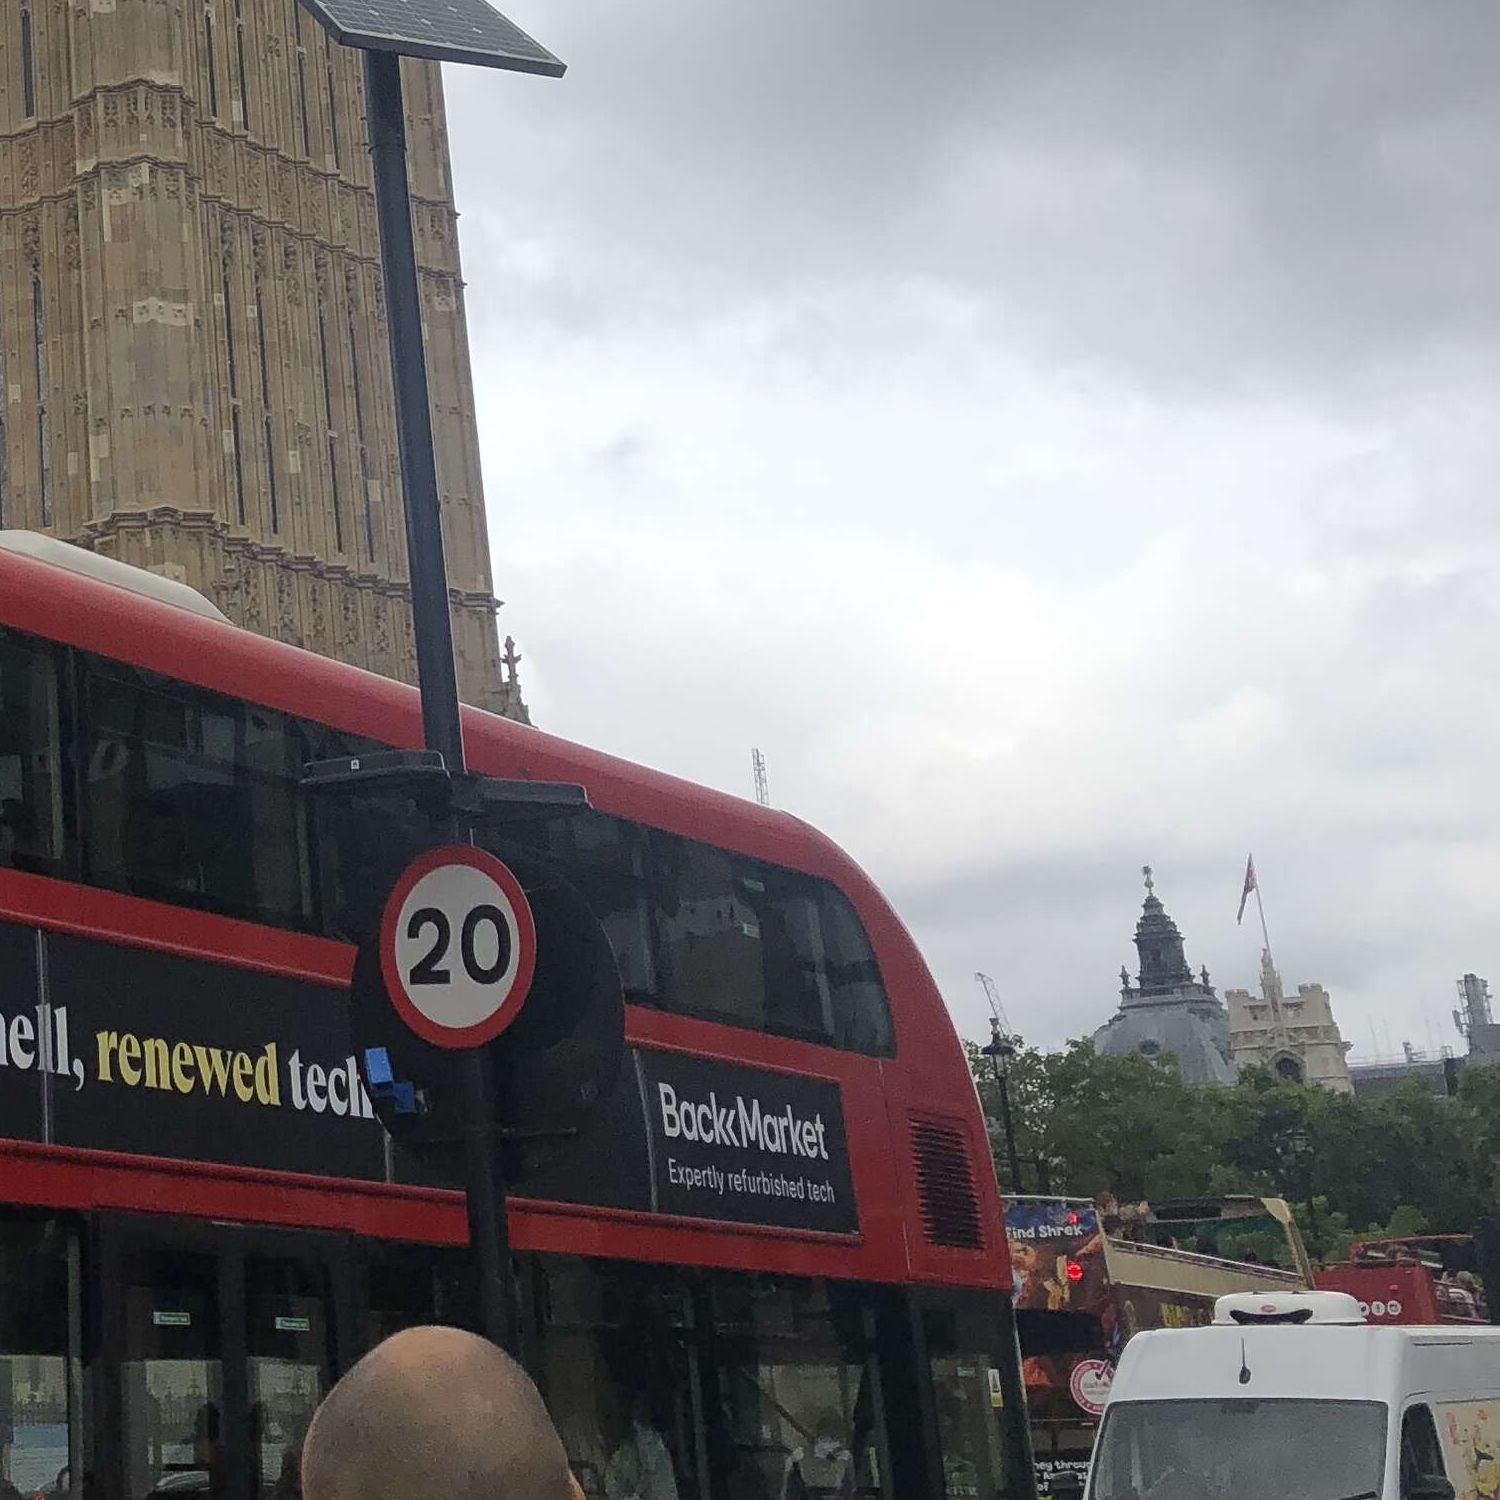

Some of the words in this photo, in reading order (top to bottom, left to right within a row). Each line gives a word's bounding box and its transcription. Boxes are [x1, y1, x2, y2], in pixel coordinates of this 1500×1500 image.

[407, 904, 511, 986] 20
[96, 1030, 282, 1107] renewed
[288, 1048, 375, 1120] tech
[668, 1158, 724, 1195] Expertly
[727, 1168, 805, 1199] refurbished
[808, 1179, 836, 1203] tech
[1038, 1224, 1083, 1238] Shrek
